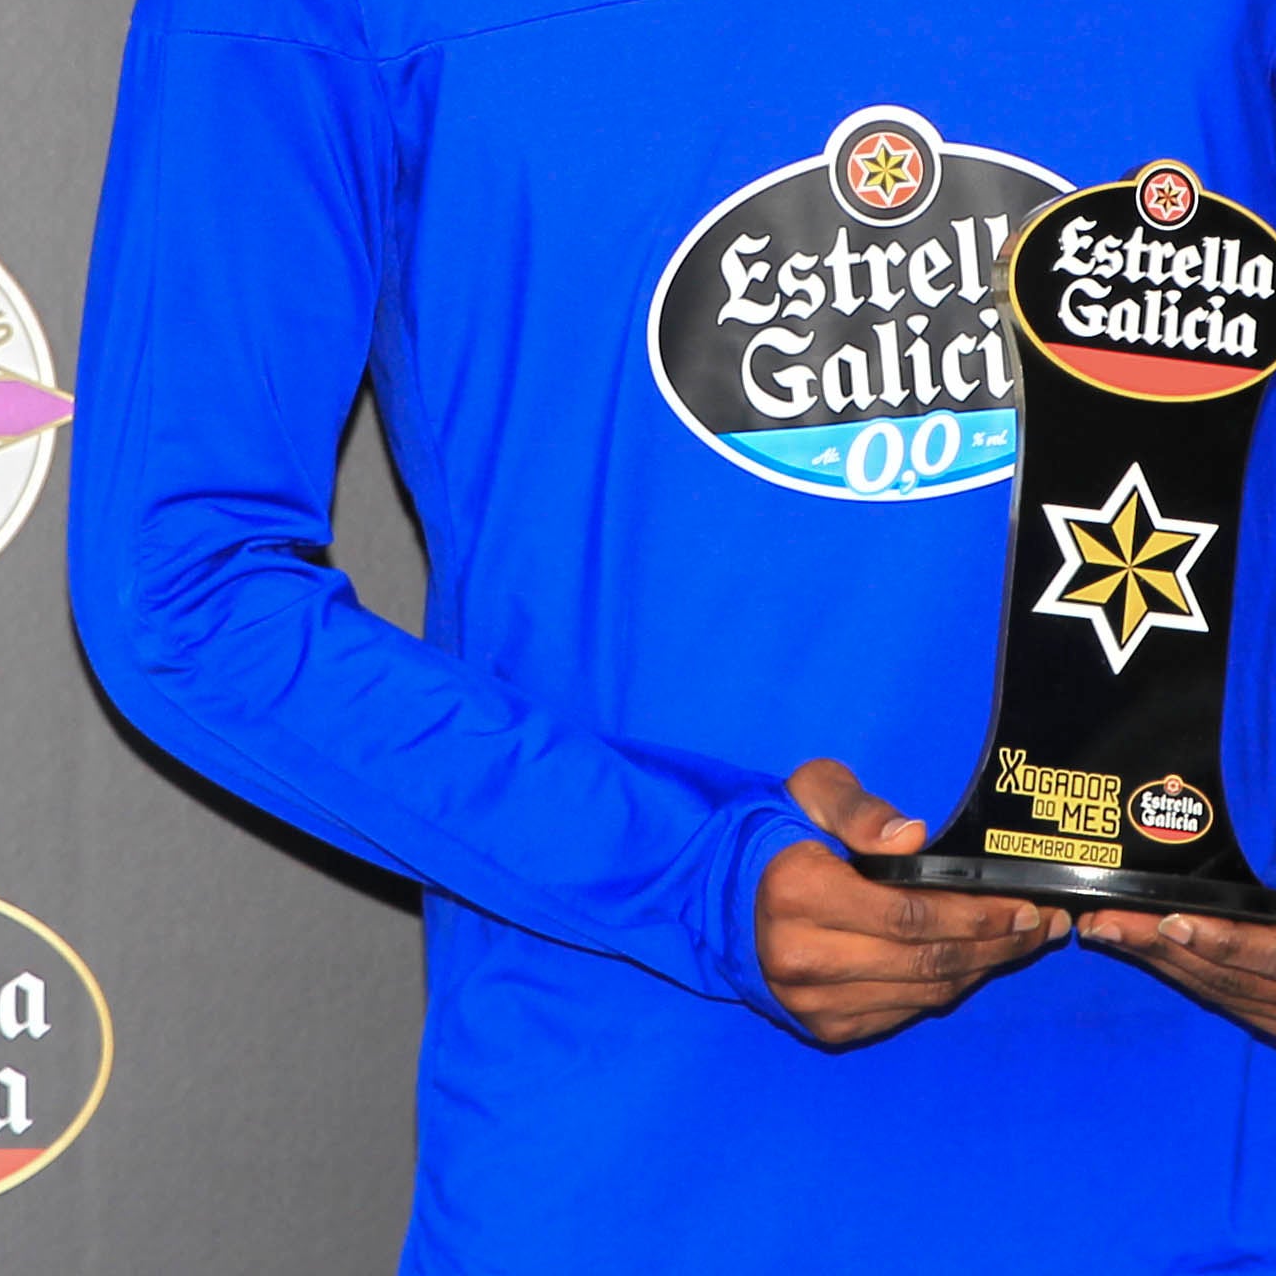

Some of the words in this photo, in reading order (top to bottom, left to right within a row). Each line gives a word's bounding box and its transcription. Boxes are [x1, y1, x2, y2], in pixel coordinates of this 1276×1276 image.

[718, 214, 1009, 325] Estrel
[1052, 215, 1275, 299] Estrella
[1057, 277, 1259, 358] Galicia
[742, 308, 1015, 419] Galici
[845, 412, 961, 496] 0,0
[997, 748, 1120, 803] XOGADOR
[1140, 790, 1203, 816] Estrella
[988, 832, 1075, 860] NOVEMBRO
[1079, 843, 1119, 865] 2020
[1034, 798, 1056, 817] DO
[1061, 801, 1120, 835] MES
[1141, 808, 1199, 833] Galicia
